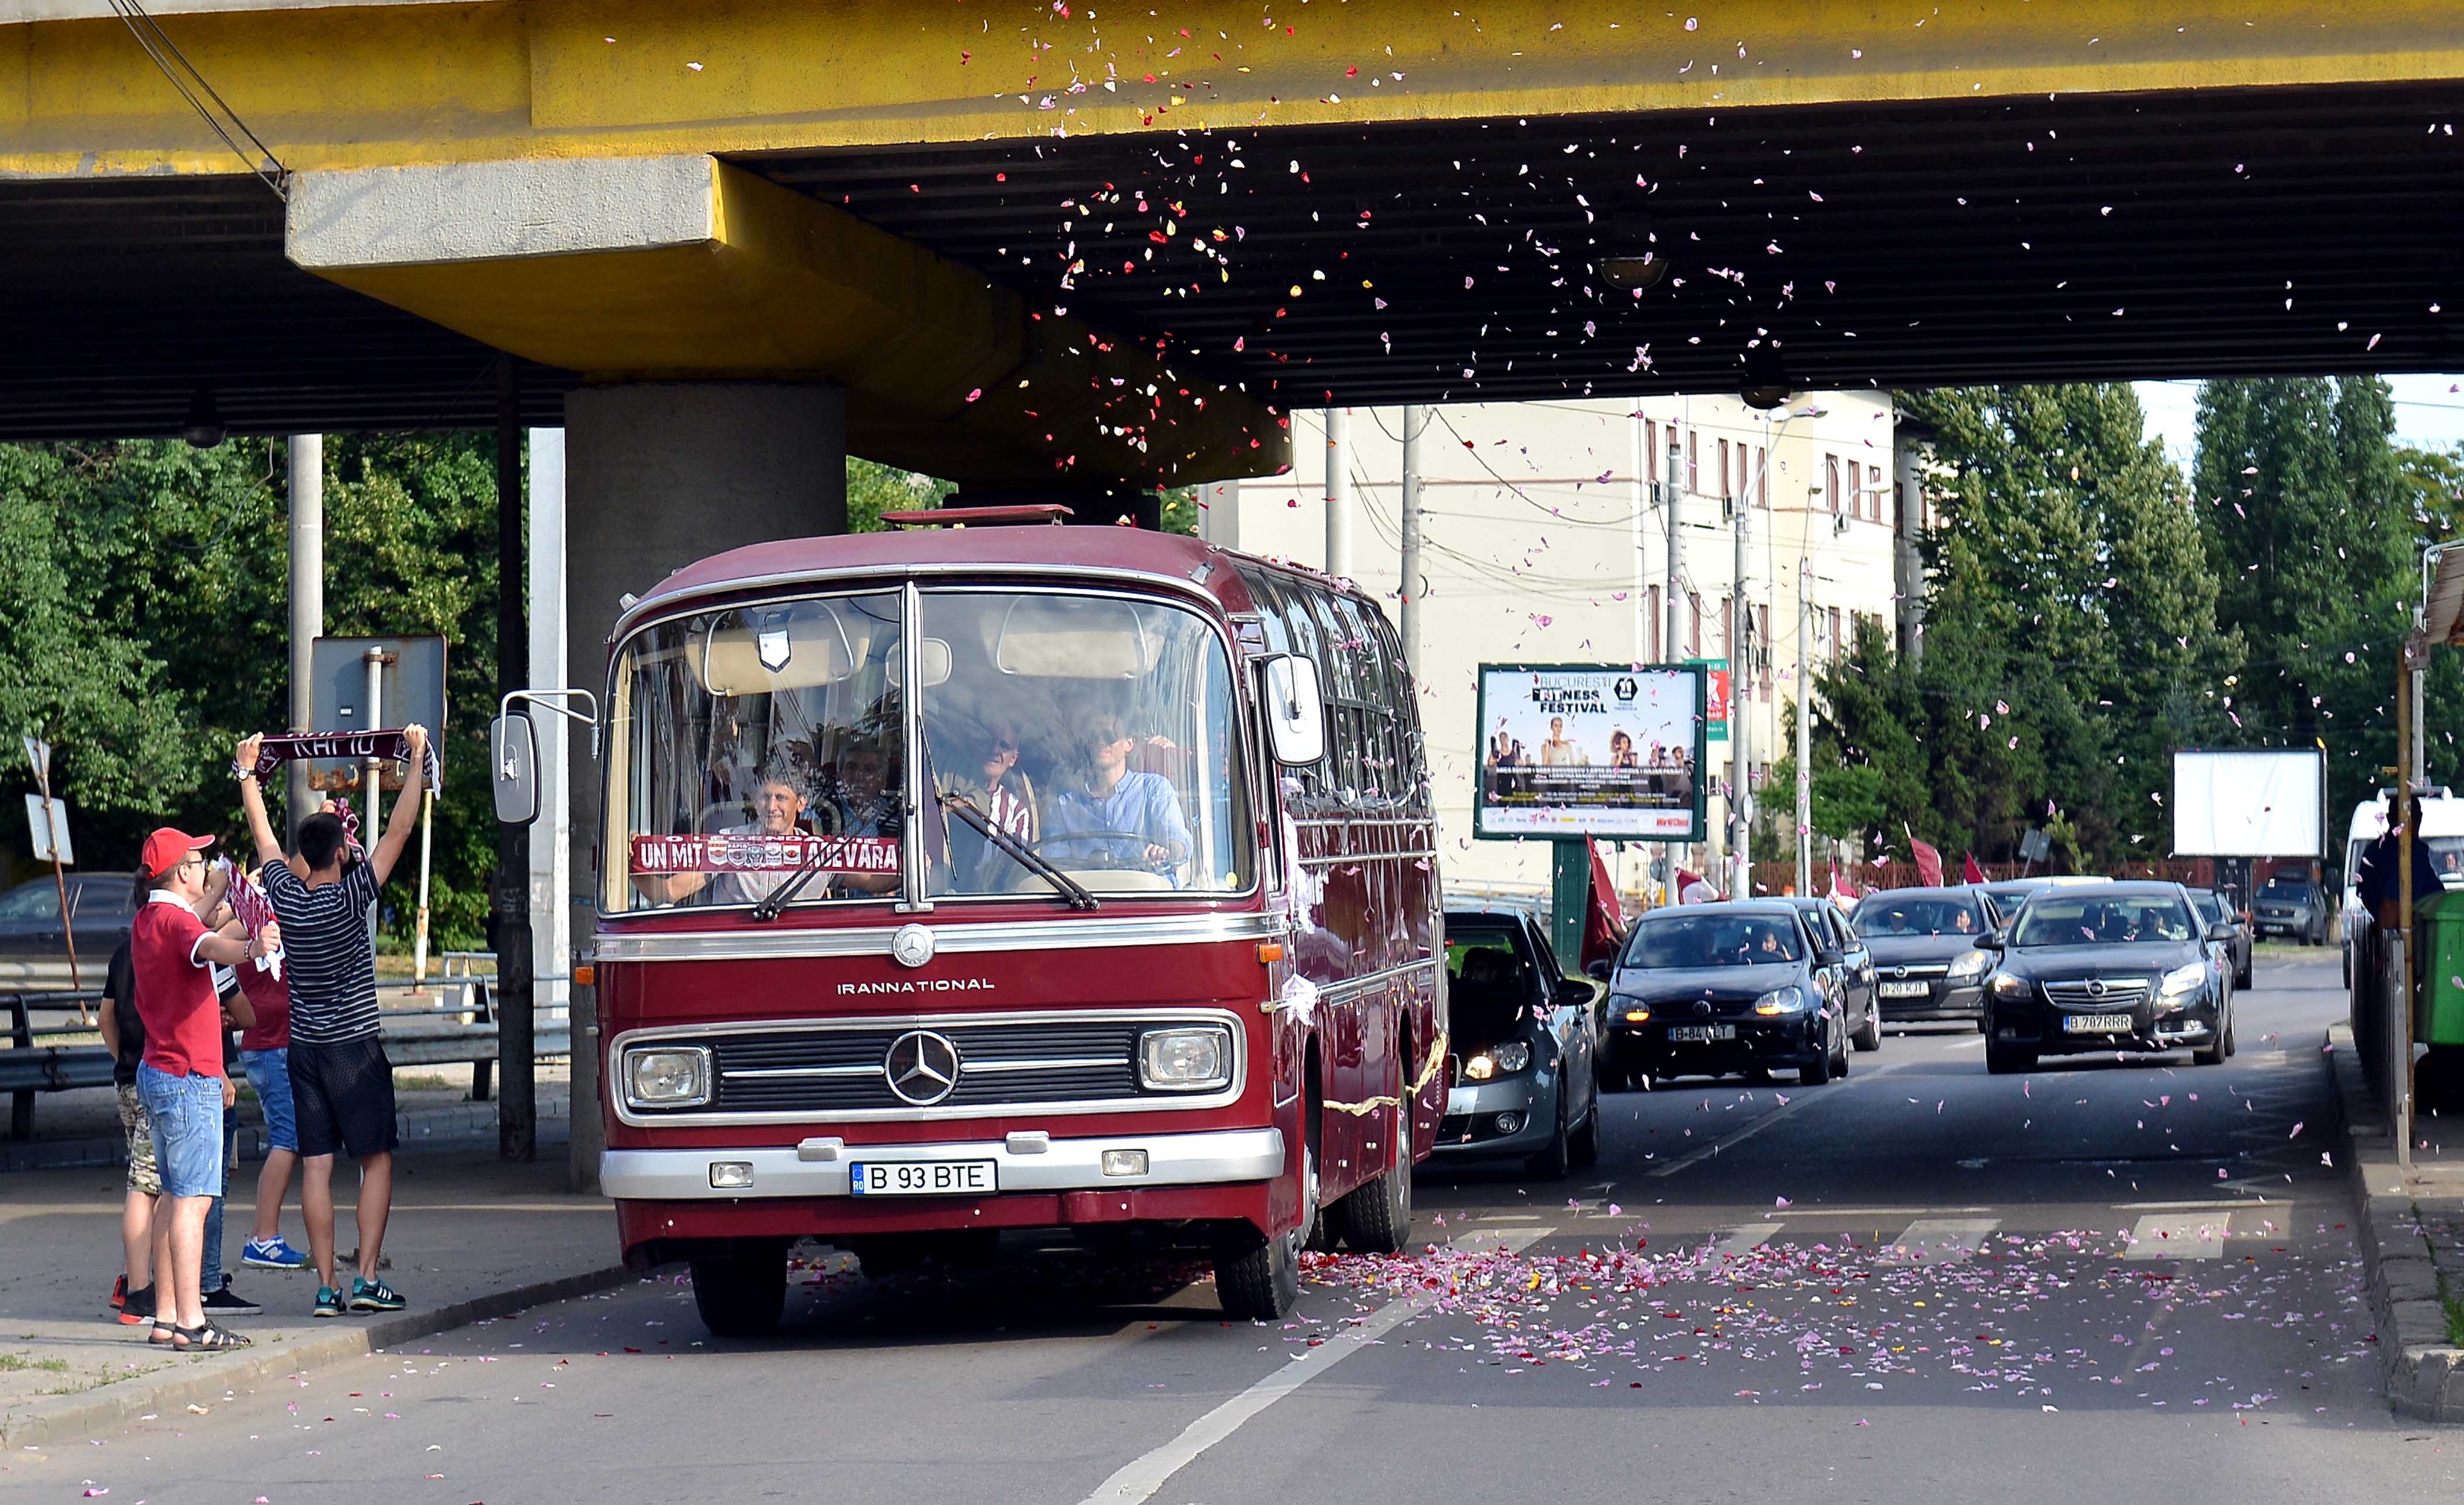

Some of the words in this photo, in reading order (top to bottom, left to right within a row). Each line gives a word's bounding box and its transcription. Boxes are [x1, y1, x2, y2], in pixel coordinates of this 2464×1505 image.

[1540, 703, 1607, 713] FESTIVAL
[641, 843, 667, 869] UN
[672, 843, 703, 869] MIT
[837, 978, 995, 995] IRANNATIONAL
[871, 1167, 887, 1189] B
[898, 1167, 926, 1188] 93
[935, 1165, 985, 1188] BTE
[853, 1181, 864, 1191] RO
